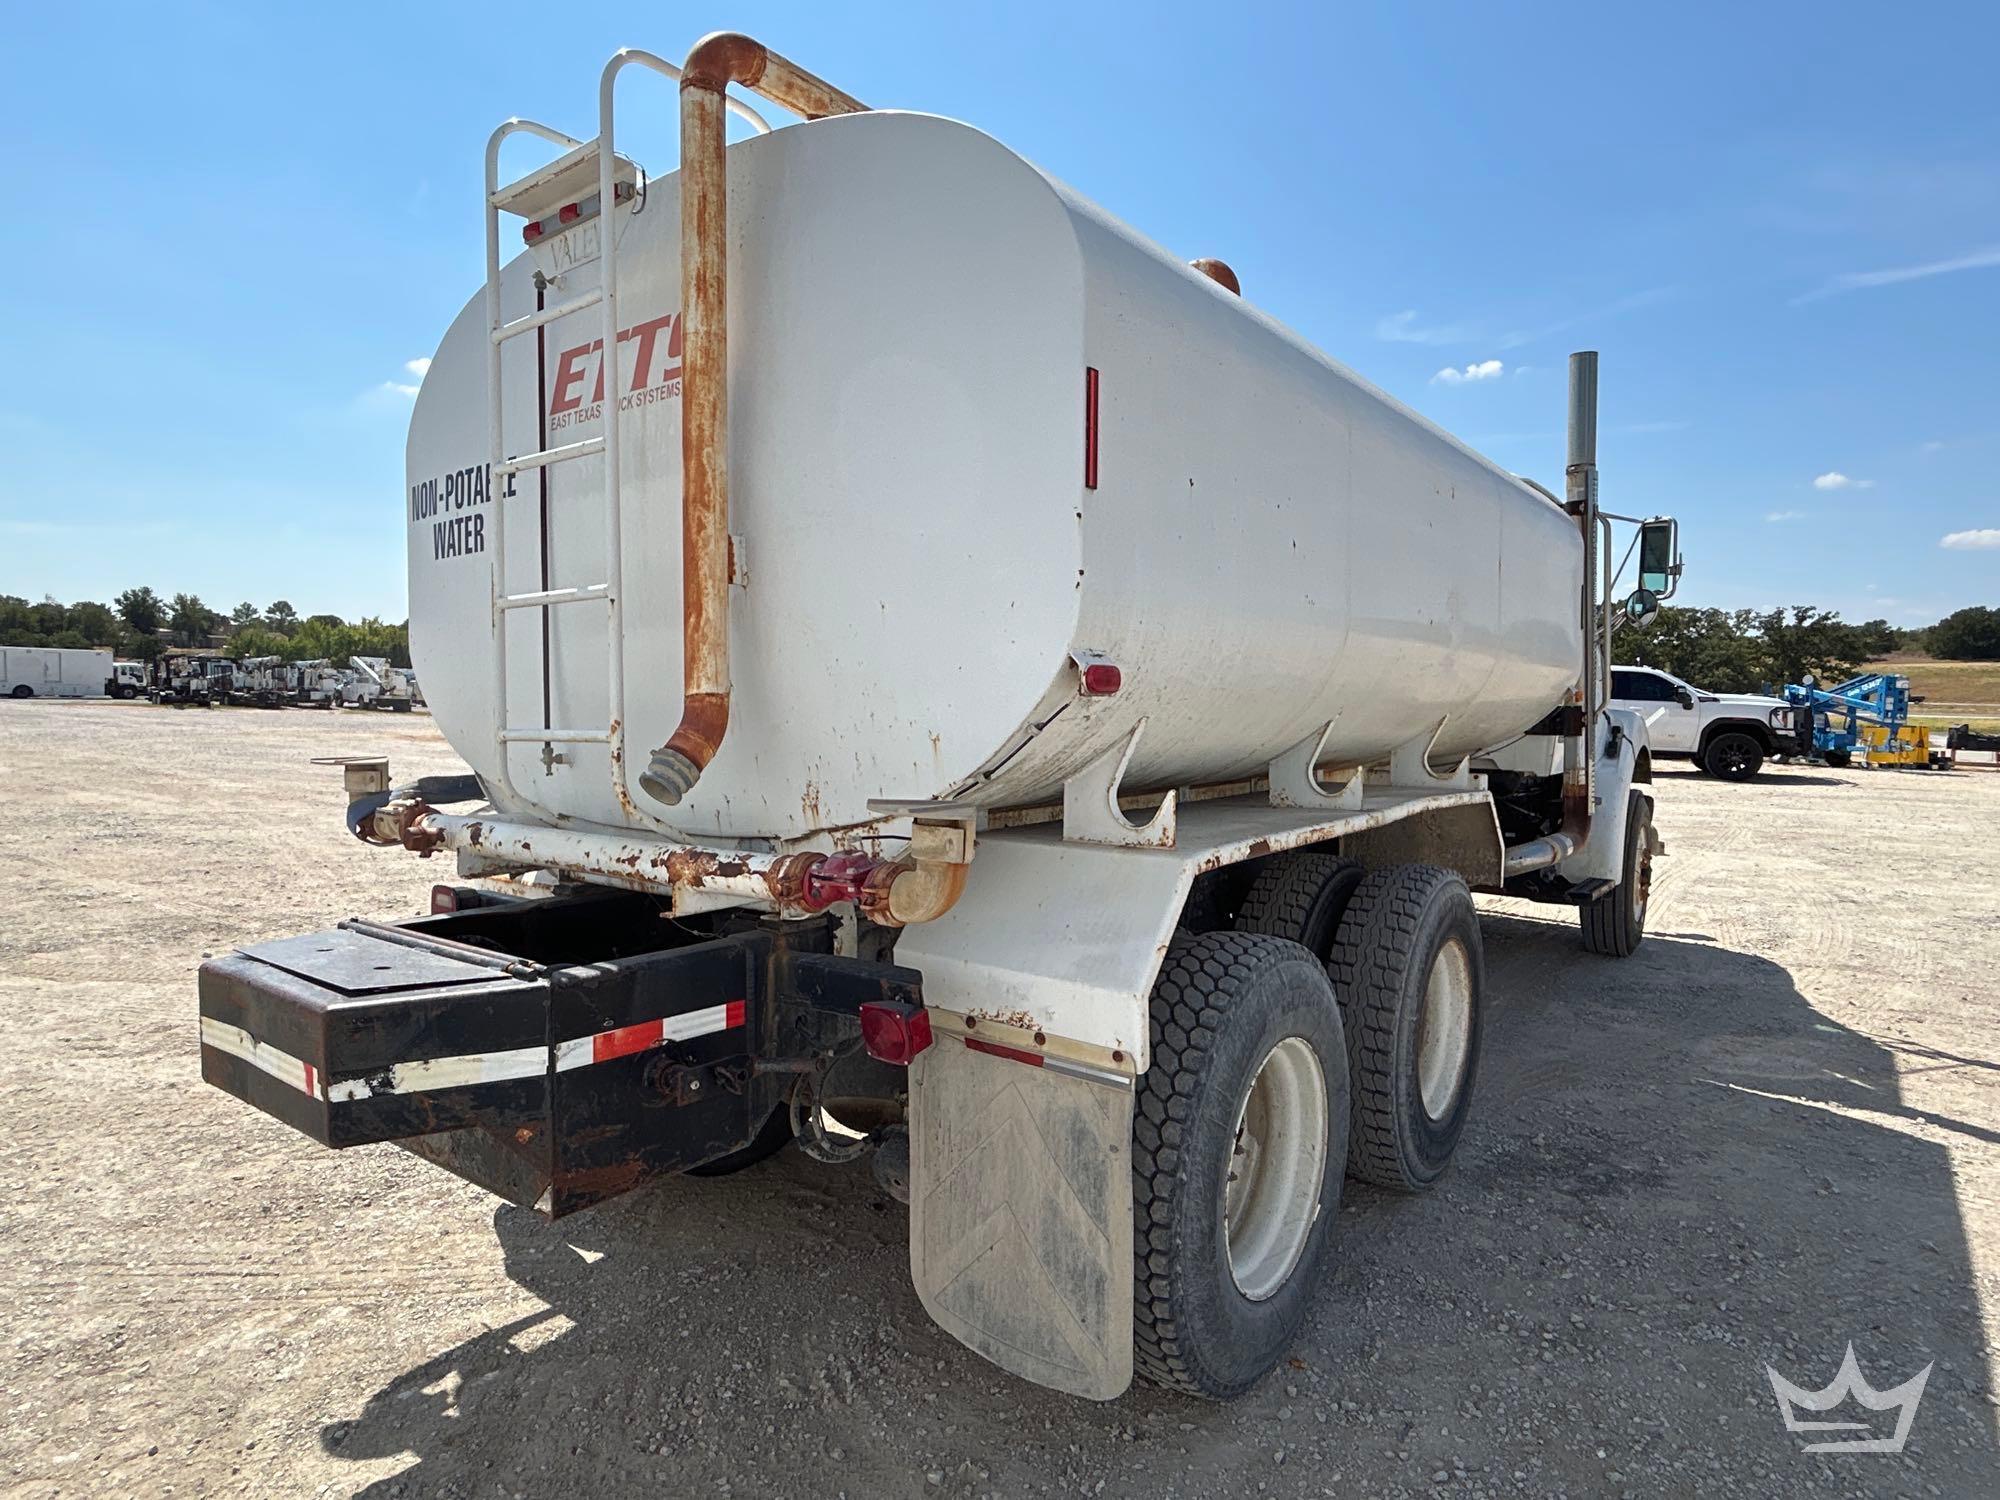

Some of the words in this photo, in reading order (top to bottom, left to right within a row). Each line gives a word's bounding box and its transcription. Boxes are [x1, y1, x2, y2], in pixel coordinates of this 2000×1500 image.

[550, 222, 601, 272] VALE
[551, 413, 573, 431] EAST
[574, 404, 602, 425] TEXAS
[636, 381, 681, 407] SYSTEMS
[411, 456, 517, 522] NON-POTAE
[433, 513, 485, 561] WATER
